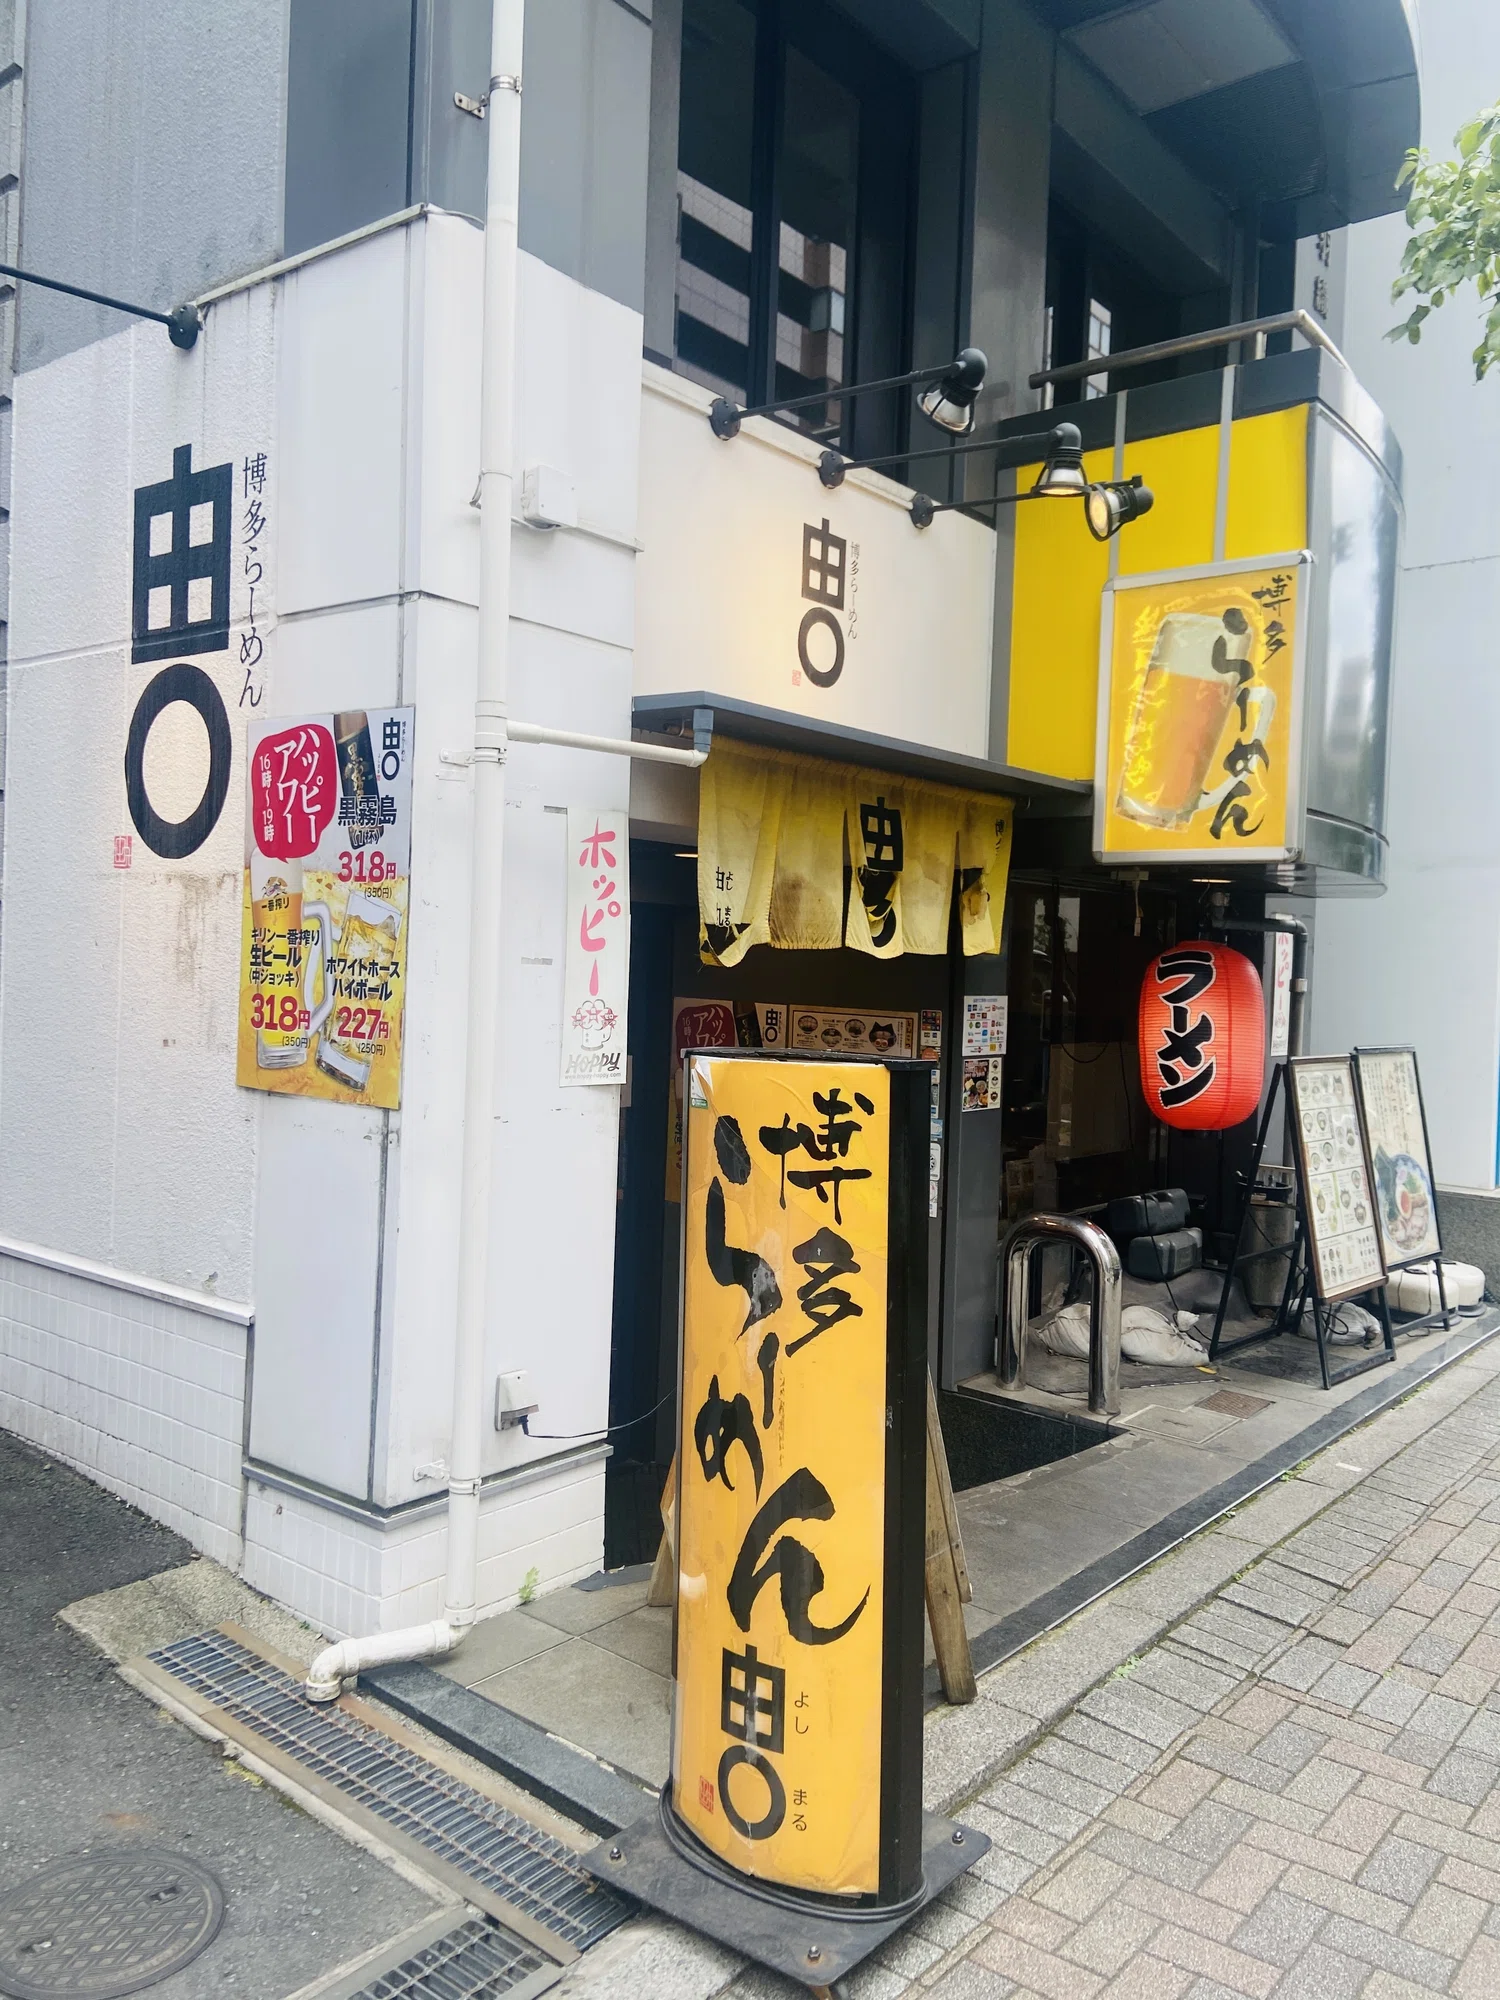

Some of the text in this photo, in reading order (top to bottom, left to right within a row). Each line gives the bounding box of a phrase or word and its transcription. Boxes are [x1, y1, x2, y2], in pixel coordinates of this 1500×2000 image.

[238, 453, 268, 708] 博多らーめん
[1252, 574, 1292, 664] 博多
[1209, 607, 1270, 839] らーめん
[274, 740, 299, 844] アワー
[293, 728, 323, 843] ハッピー
[338, 794, 397, 826] 黒霧島
[337, 851, 397, 883] 318円
[261, 897, 290, 911] 一番搾り
[364, 887, 393, 900] (350円)
[579, 817, 621, 996] ホッピー
[251, 927, 320, 946] キリン一番搾り
[250, 944, 302, 968] 生ビール
[326, 957, 400, 979] ホワイトホース
[332, 978, 392, 1002] ハイボール
[250, 993, 311, 1032] 318円
[337, 1006, 389, 1040] 227円
[1156, 949, 1216, 1110] ラーメン
[282, 1036, 311, 1049] (350円)
[358, 1042, 386, 1056] (250円)
[565, 1052, 621, 1074] Hoppy
[758, 1088, 876, 1358] 博多
[694, 1114, 871, 1646] らーめん
[792, 1691, 809, 1832] よし まる
